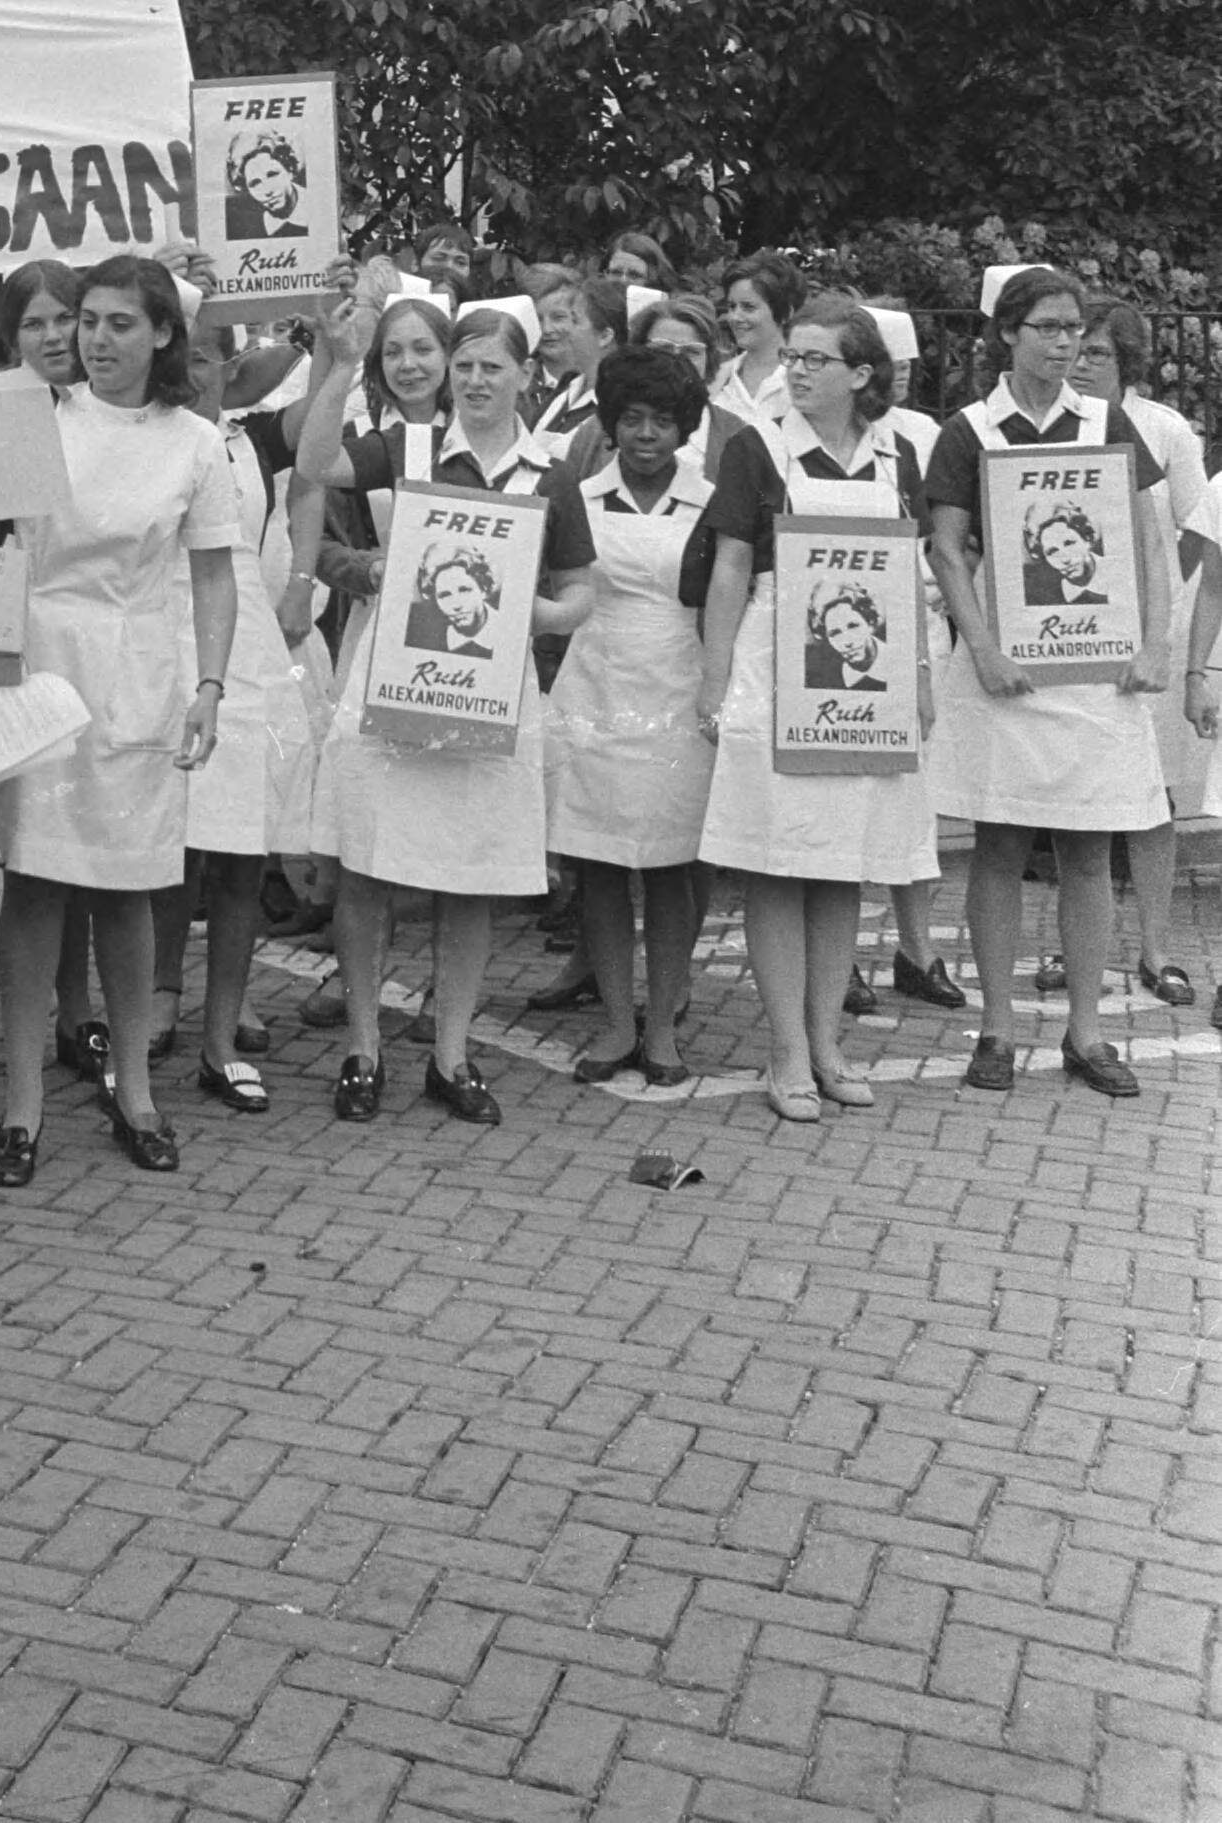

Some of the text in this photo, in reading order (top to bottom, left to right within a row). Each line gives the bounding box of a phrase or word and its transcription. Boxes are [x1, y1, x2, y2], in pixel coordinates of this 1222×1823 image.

[224, 96, 307, 121] FREE
[238, 248, 298, 276] Ruth
[212, 272, 328, 294] LEXANDROVITC
[1019, 469, 1102, 491] FREE
[423, 508, 514, 539] FREE
[806, 548, 890, 571] FREE
[1039, 614, 1100, 640] Ruth
[1011, 640, 1134, 659] ALEXANDROVITCH
[410, 660, 477, 688] Ruth
[378, 683, 510, 717] ALEXANDROVITCH
[815, 699, 876, 725] Ruth
[786, 727, 909, 746] ALEXANDROVITCH
